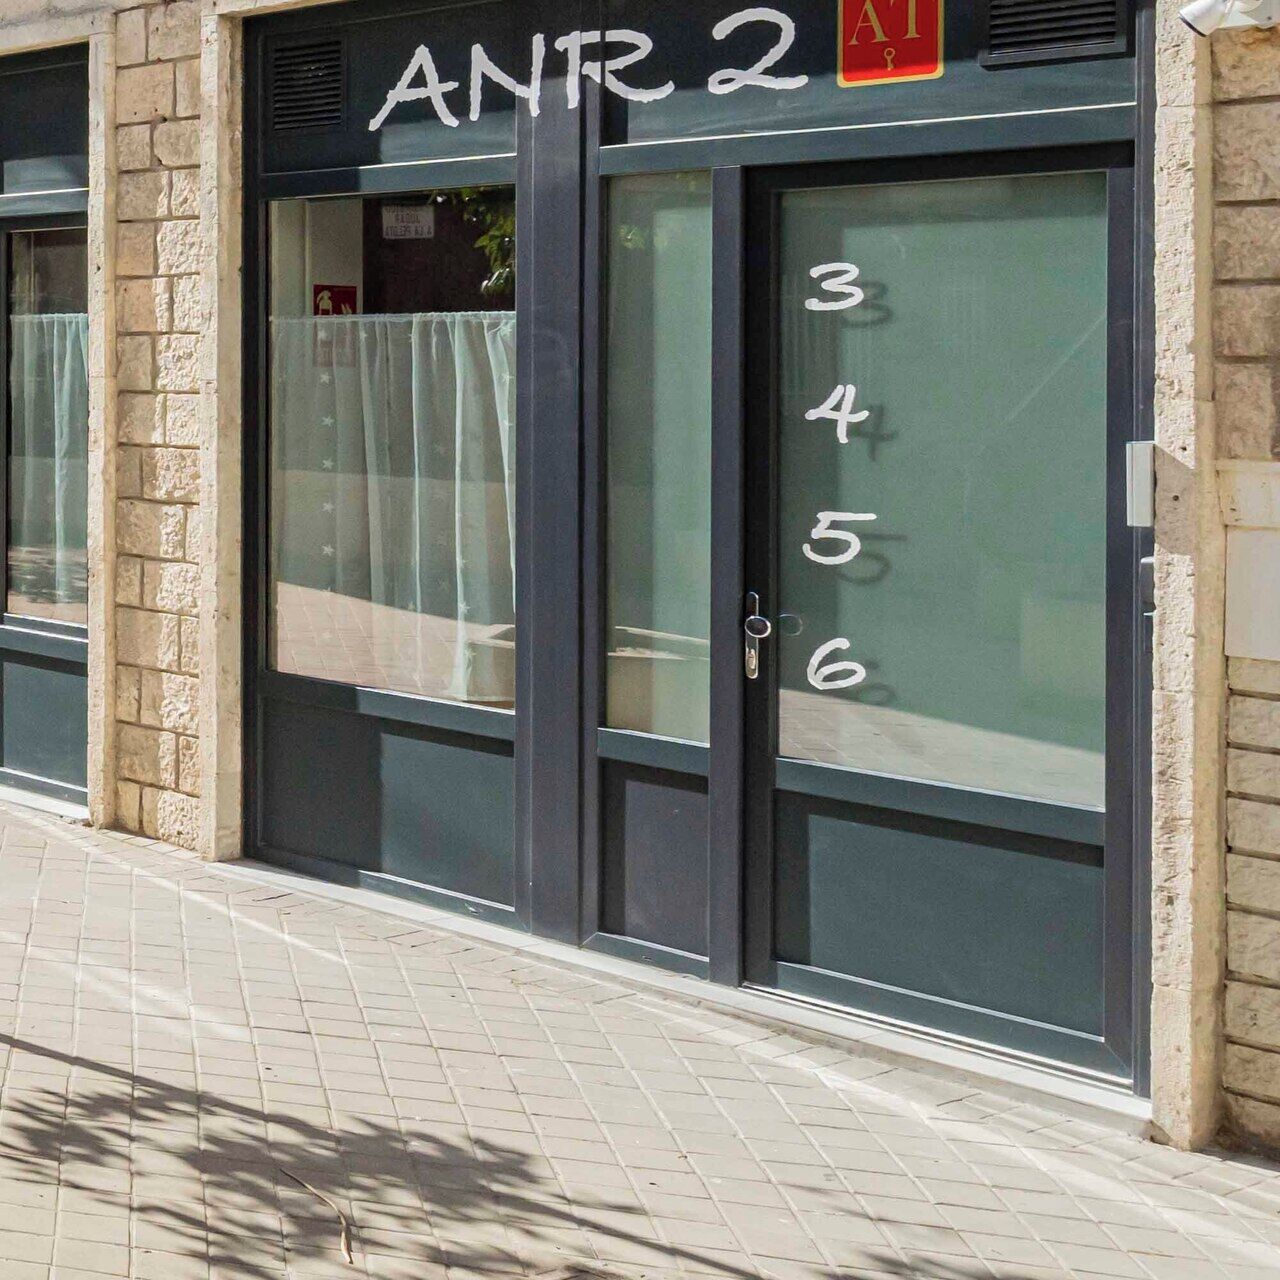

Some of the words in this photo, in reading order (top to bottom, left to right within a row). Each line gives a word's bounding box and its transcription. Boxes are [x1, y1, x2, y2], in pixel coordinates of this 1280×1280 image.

[368, 29, 675, 131] ANR
[708, 7, 808, 95] 2
[804, 262, 864, 311] 3
[804, 384, 869, 444] 4
[802, 510, 877, 565] 5
[807, 637, 867, 690] 6
